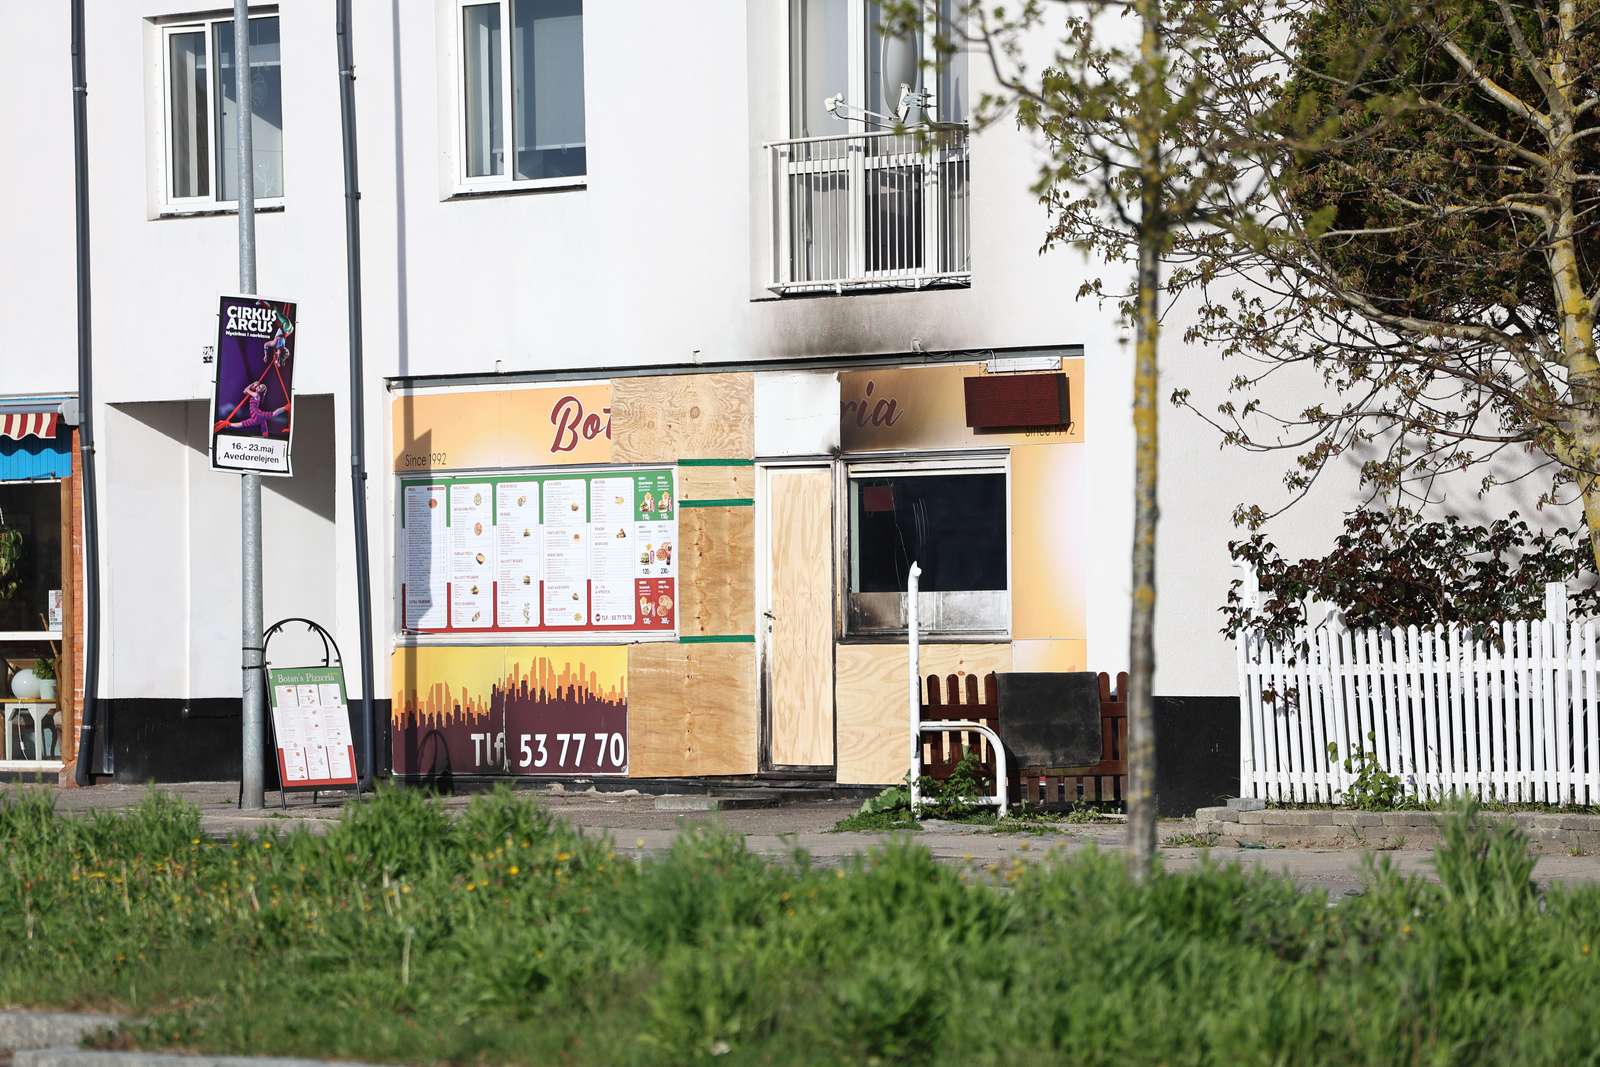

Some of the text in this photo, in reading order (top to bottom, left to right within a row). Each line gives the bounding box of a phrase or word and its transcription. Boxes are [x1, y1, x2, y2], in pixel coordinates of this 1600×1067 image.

[227, 305, 277, 321] CIRKUS
[226, 317, 273, 333] ARCUS
[405, 453, 447, 467] Since 1992
[519, 733, 548, 767] 53
[556, 733, 586, 767] 77
[594, 732, 625, 767] 70
